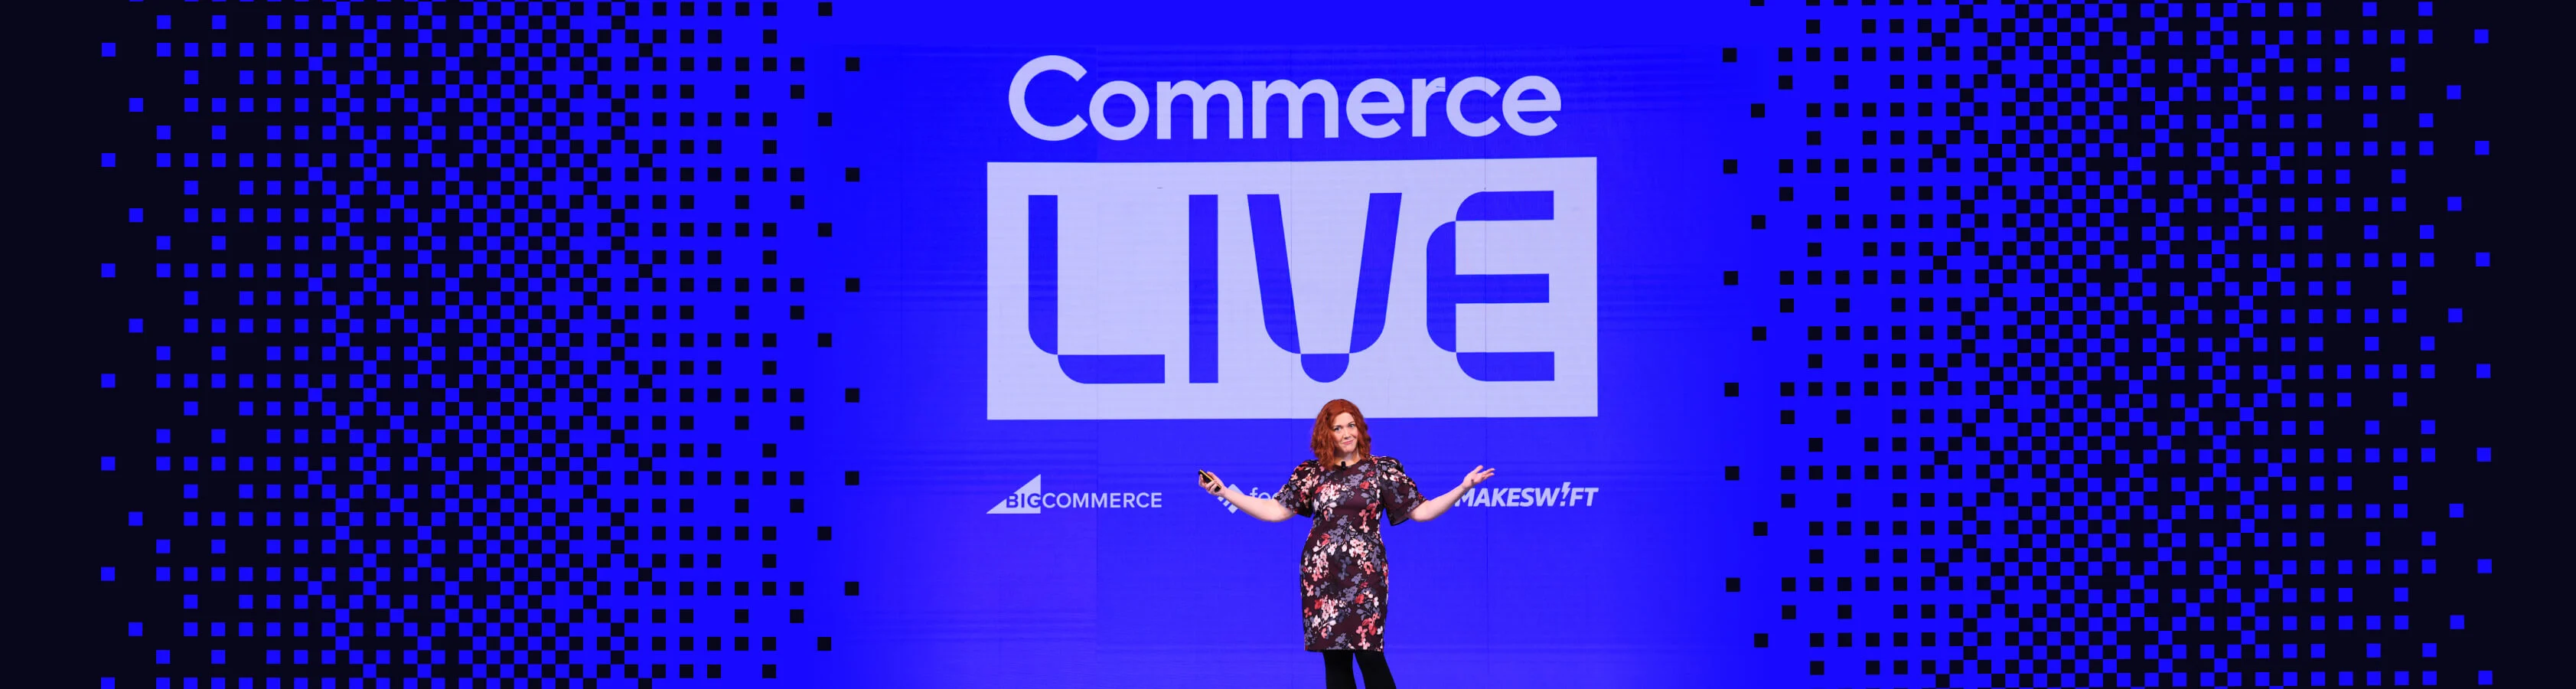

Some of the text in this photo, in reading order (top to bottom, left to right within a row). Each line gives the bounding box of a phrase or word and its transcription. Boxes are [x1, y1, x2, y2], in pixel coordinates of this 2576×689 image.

[1009, 54, 1562, 141] Commerce
[1028, 190, 1555, 384] LIVE
[1006, 492, 1162, 508] BIGCOMMERCE
